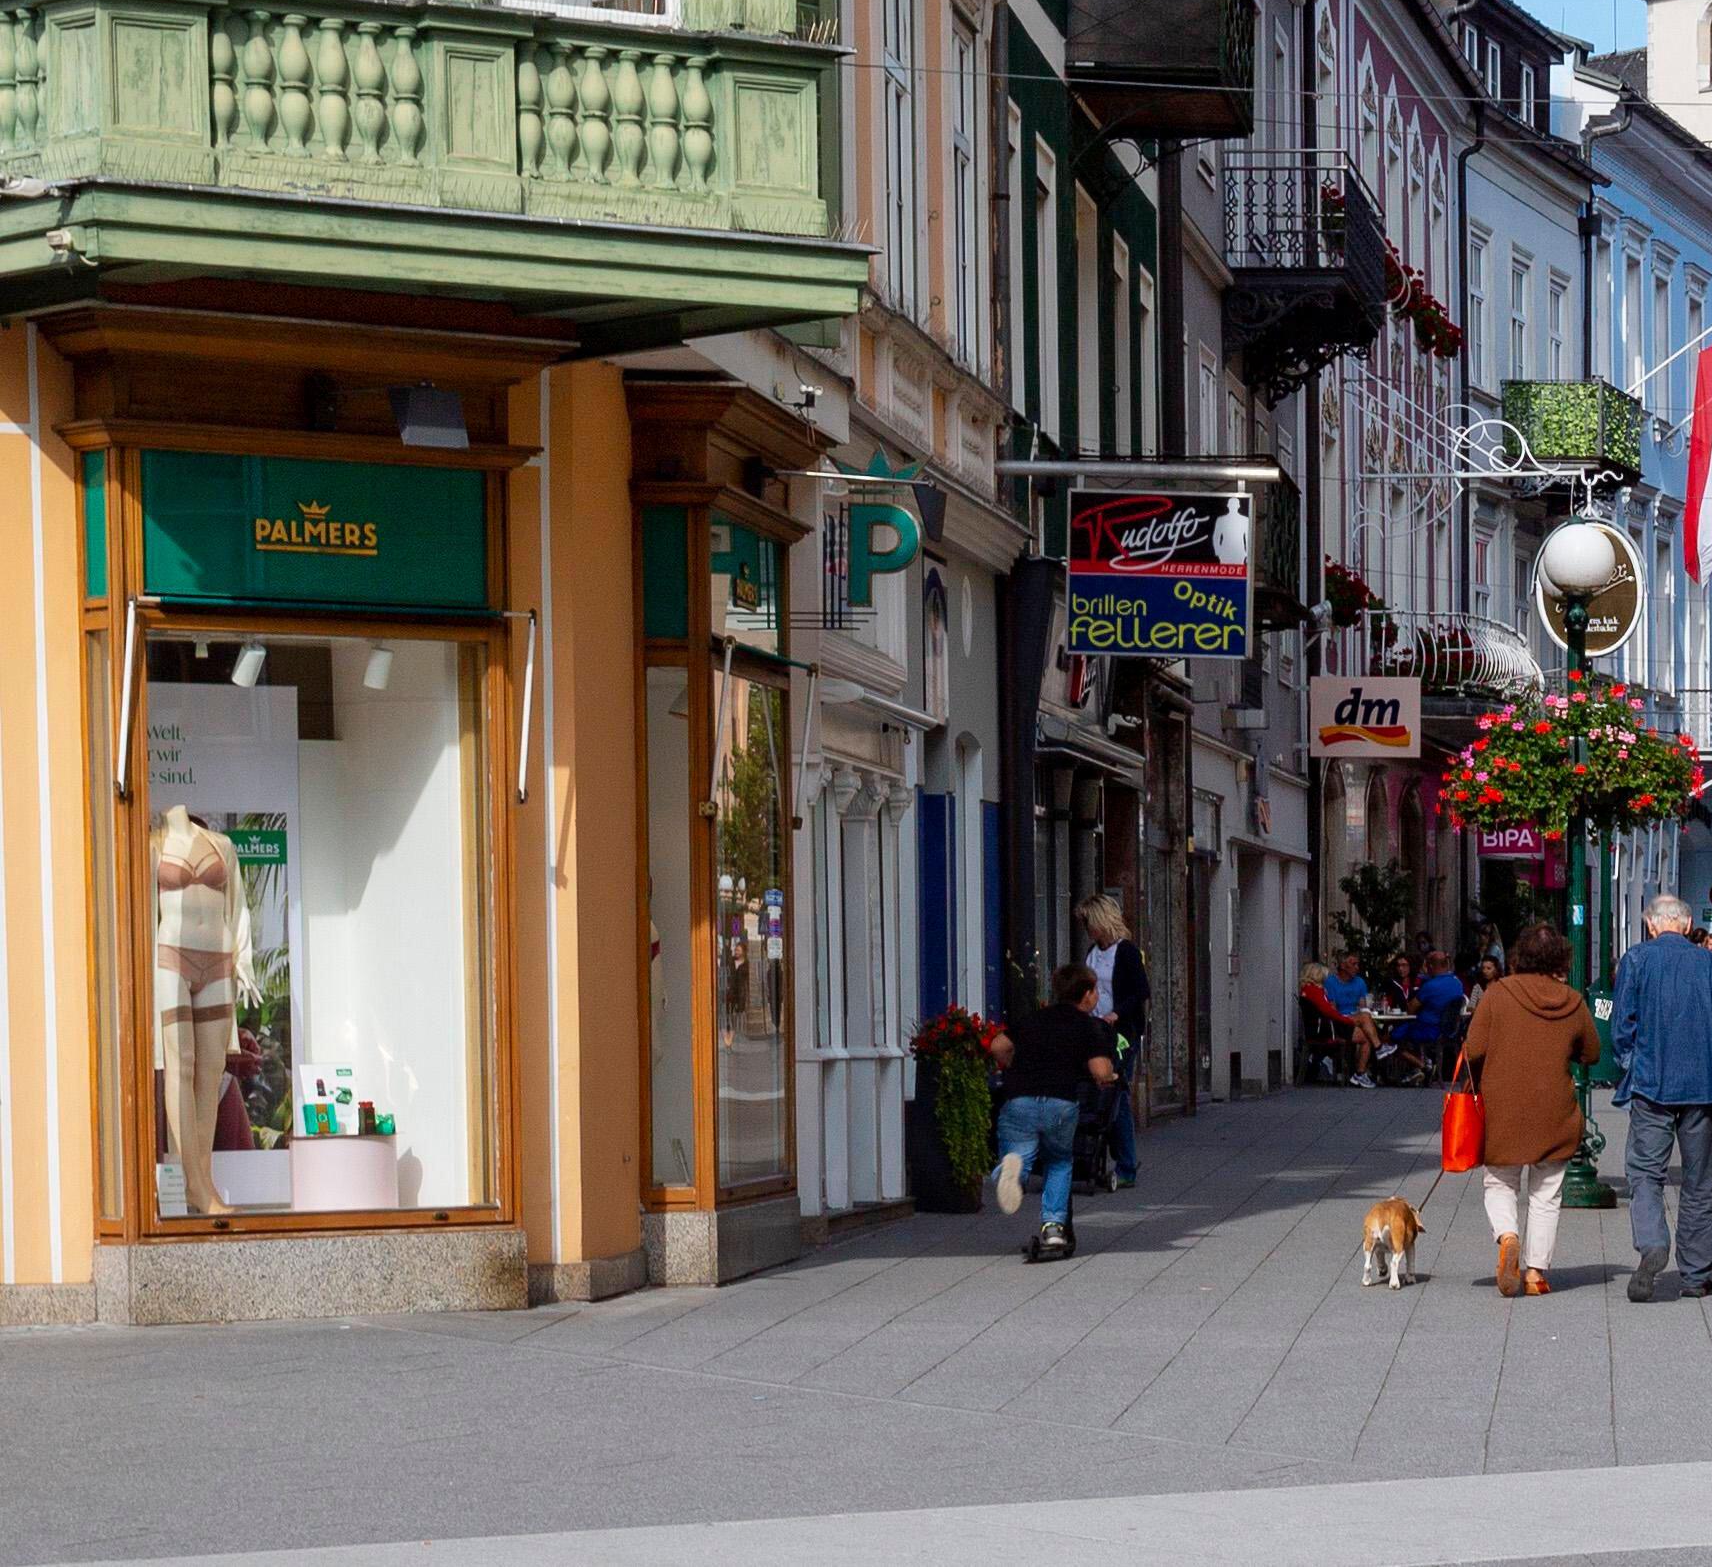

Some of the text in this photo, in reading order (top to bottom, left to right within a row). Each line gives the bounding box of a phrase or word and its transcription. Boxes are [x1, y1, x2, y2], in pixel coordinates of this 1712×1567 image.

[255, 518, 378, 548] PALMERS
[1072, 495, 1210, 571] Rudolfo
[848, 503, 921, 607] P
[1161, 564, 1243, 576] HERRENMODE
[1072, 593, 1147, 616] brillen
[1070, 616, 1245, 651] fellerer
[1334, 687, 1401, 726] dm
[147, 723, 186, 742] Welt,
[156, 746, 182, 762] wir
[159, 766, 197, 785] sind.
